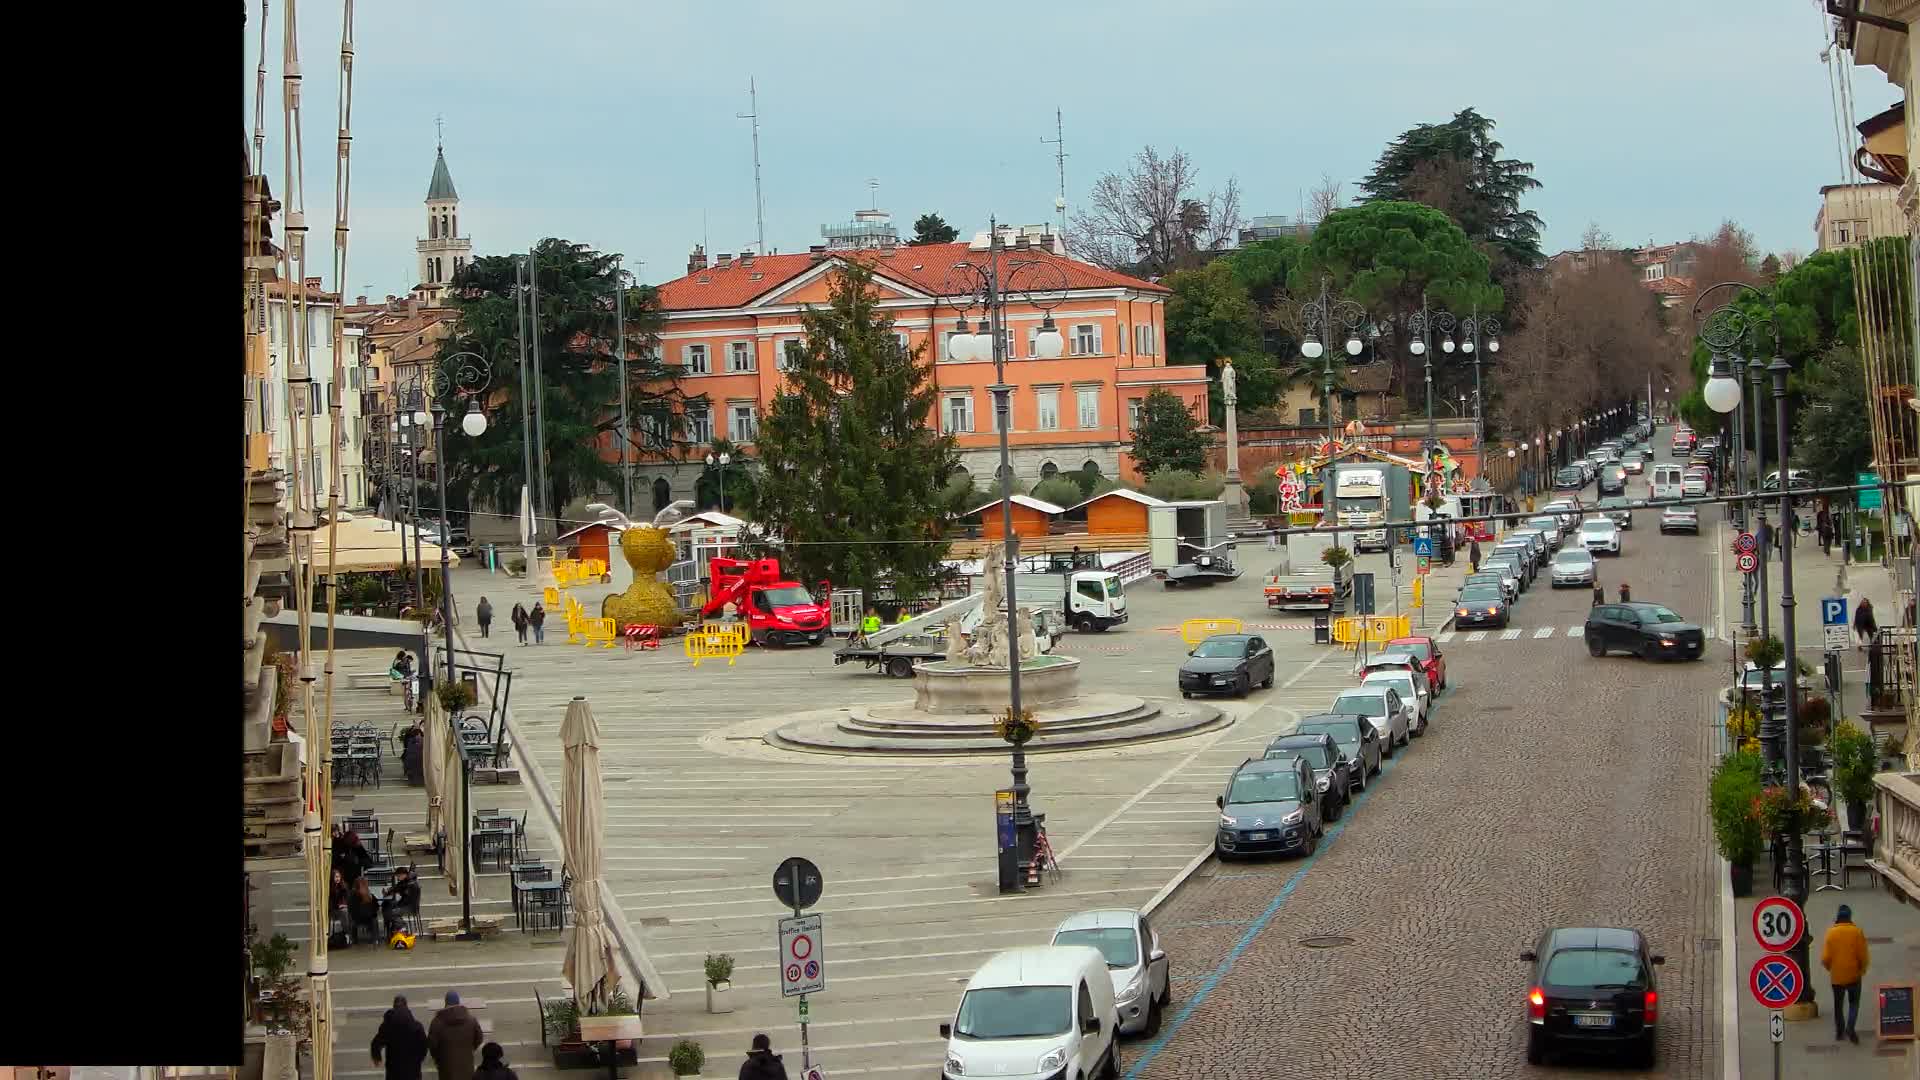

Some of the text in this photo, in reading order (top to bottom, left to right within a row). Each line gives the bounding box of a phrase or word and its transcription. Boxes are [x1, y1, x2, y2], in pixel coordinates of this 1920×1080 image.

[1742, 557, 1752, 567] 20
[1827, 602, 1842, 622] P
[1762, 911, 1792, 938] 30
[790, 968, 798, 978] 10
